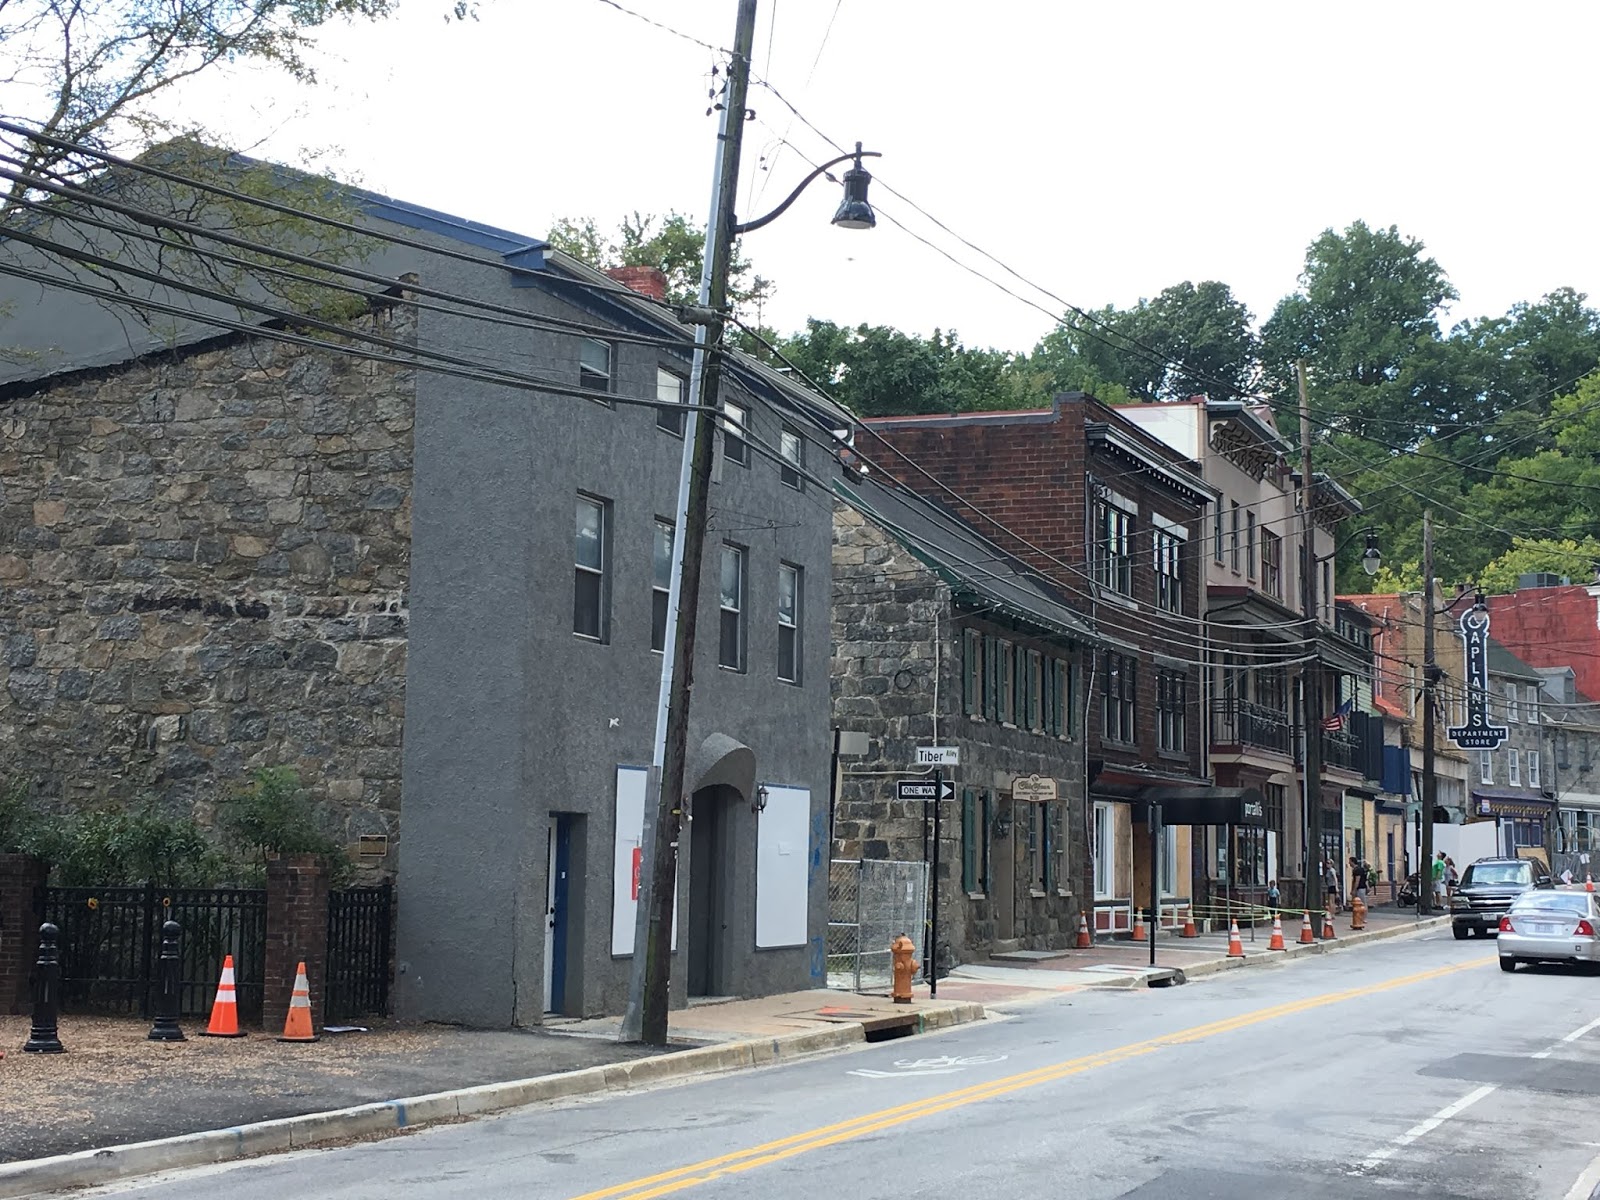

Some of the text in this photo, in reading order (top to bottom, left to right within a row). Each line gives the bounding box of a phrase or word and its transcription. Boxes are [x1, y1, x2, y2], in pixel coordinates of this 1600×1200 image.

[1465, 738, 1491, 746] STORE
[919, 750, 943, 762] Tiber
[903, 786, 920, 795] ONE
